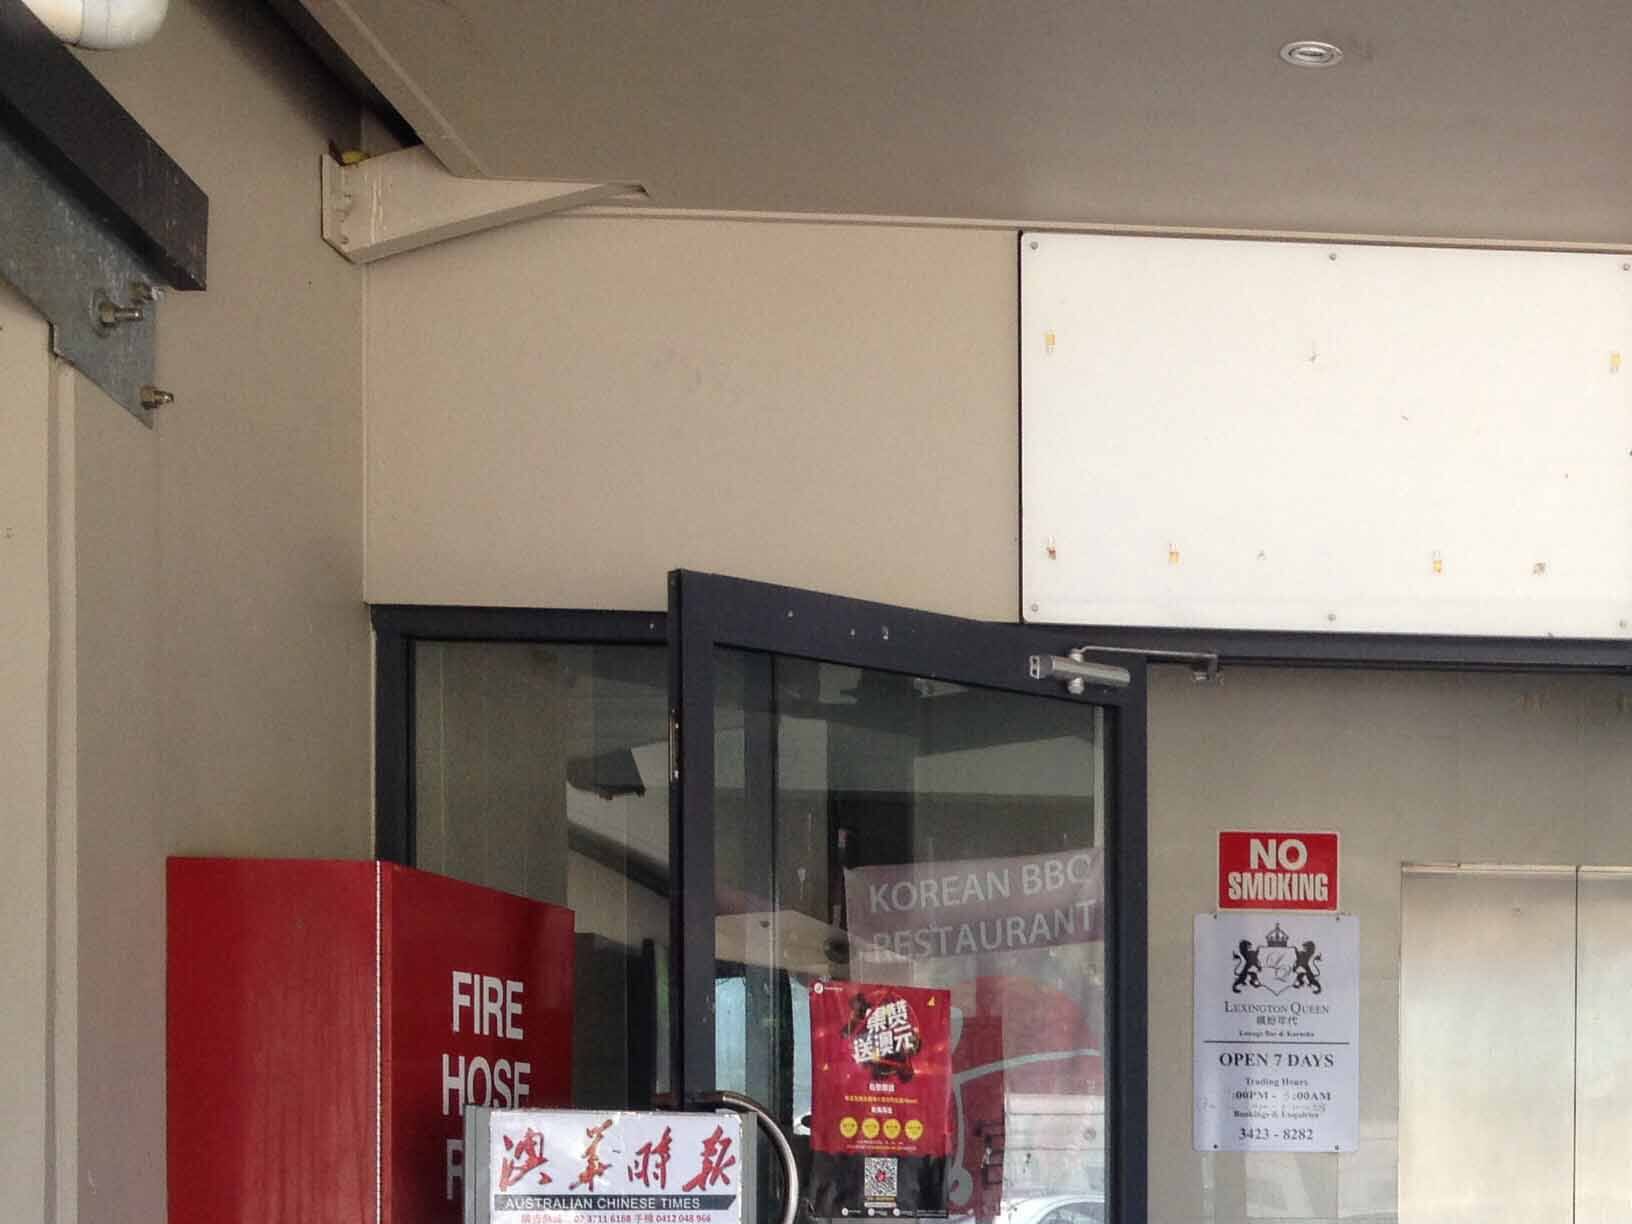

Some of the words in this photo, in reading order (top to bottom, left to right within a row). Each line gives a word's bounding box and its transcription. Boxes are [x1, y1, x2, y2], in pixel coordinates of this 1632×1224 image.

[1250, 838, 1308, 871] NO
[868, 868, 1011, 913] KOREAN
[1228, 872, 1329, 902] SMOKING
[873, 900, 1097, 962] RESTAURANT
[452, 970, 524, 1041] FIRE
[1224, 1000, 1288, 1014] LEXINGTON
[1290, 1001, 1329, 1016] QUEEN
[1219, 1052, 1268, 1067] OPEN
[1273, 1053, 1283, 1067] 7
[1287, 1053, 1335, 1067] DAYS
[442, 1053, 531, 1116] HOSE
[1245, 1078, 1279, 1088] Trading
[1281, 1078, 1308, 1087] Hours
[1239, 1128, 1270, 1141] 3423
[1283, 1128, 1314, 1141] 8282
[504, 1197, 593, 1210] AUSTRALIAN
[597, 1197, 656, 1210] CHINESE
[661, 1197, 701, 1210] TIMES
